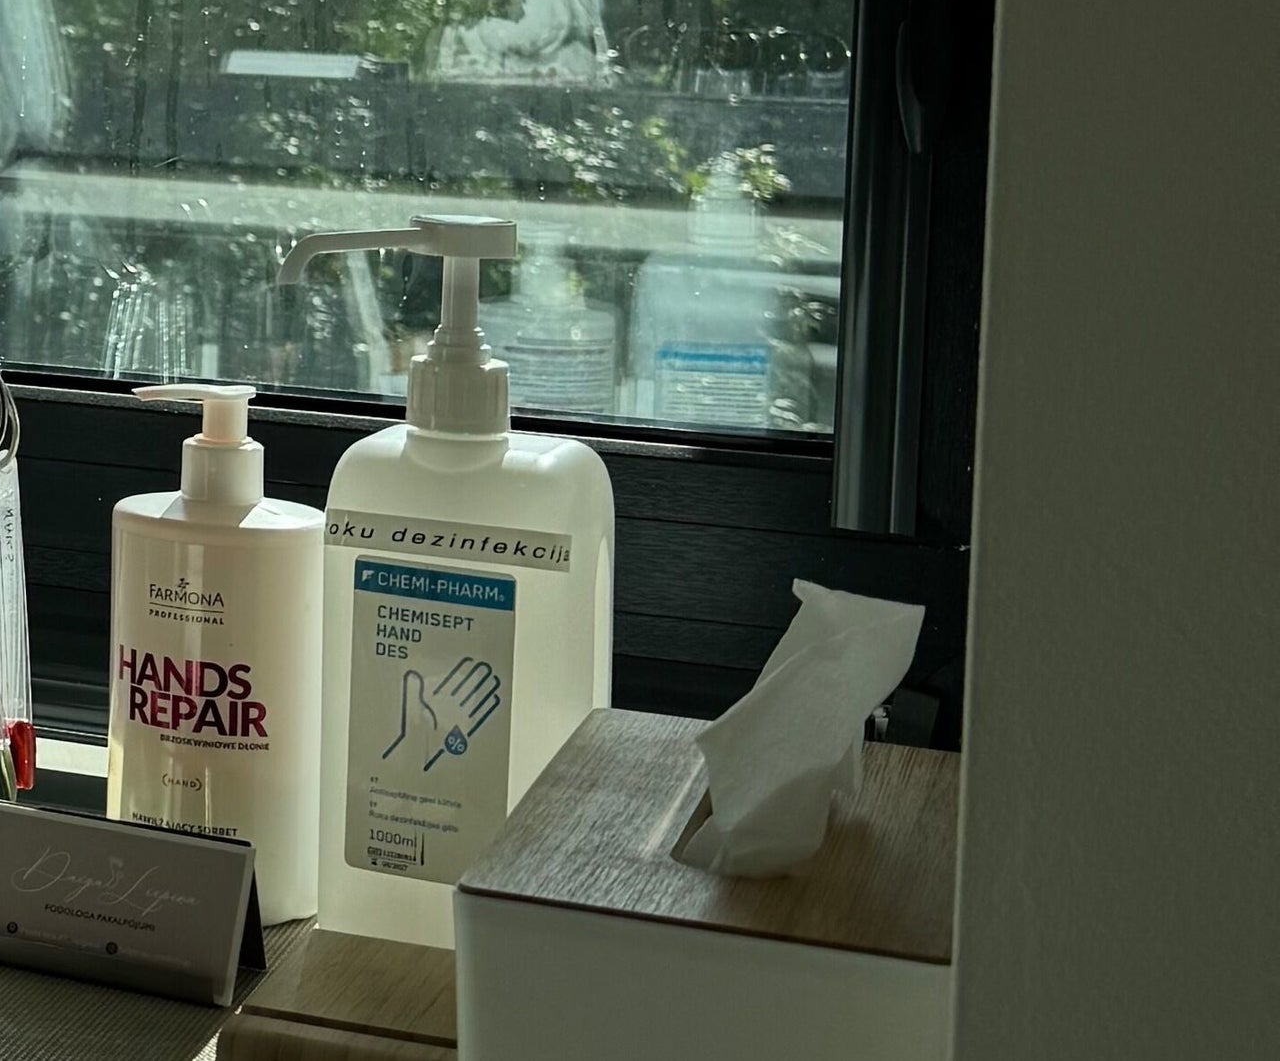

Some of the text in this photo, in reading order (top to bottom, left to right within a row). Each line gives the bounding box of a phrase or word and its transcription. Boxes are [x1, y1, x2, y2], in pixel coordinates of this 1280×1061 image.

[326, 521, 374, 538] oku
[149, 584, 224, 608] FARMONA
[378, 571, 499, 601] CHEMI-PHARM
[149, 609, 224, 626] PROFESSIONAL
[377, 605, 474, 631] CHEMISEPT
[376, 624, 422, 643] HAND
[376, 642, 408, 660] DES
[119, 644, 252, 700] HANDS
[130, 685, 268, 737] REPAIR
[369, 828, 417, 847] 1000ml
